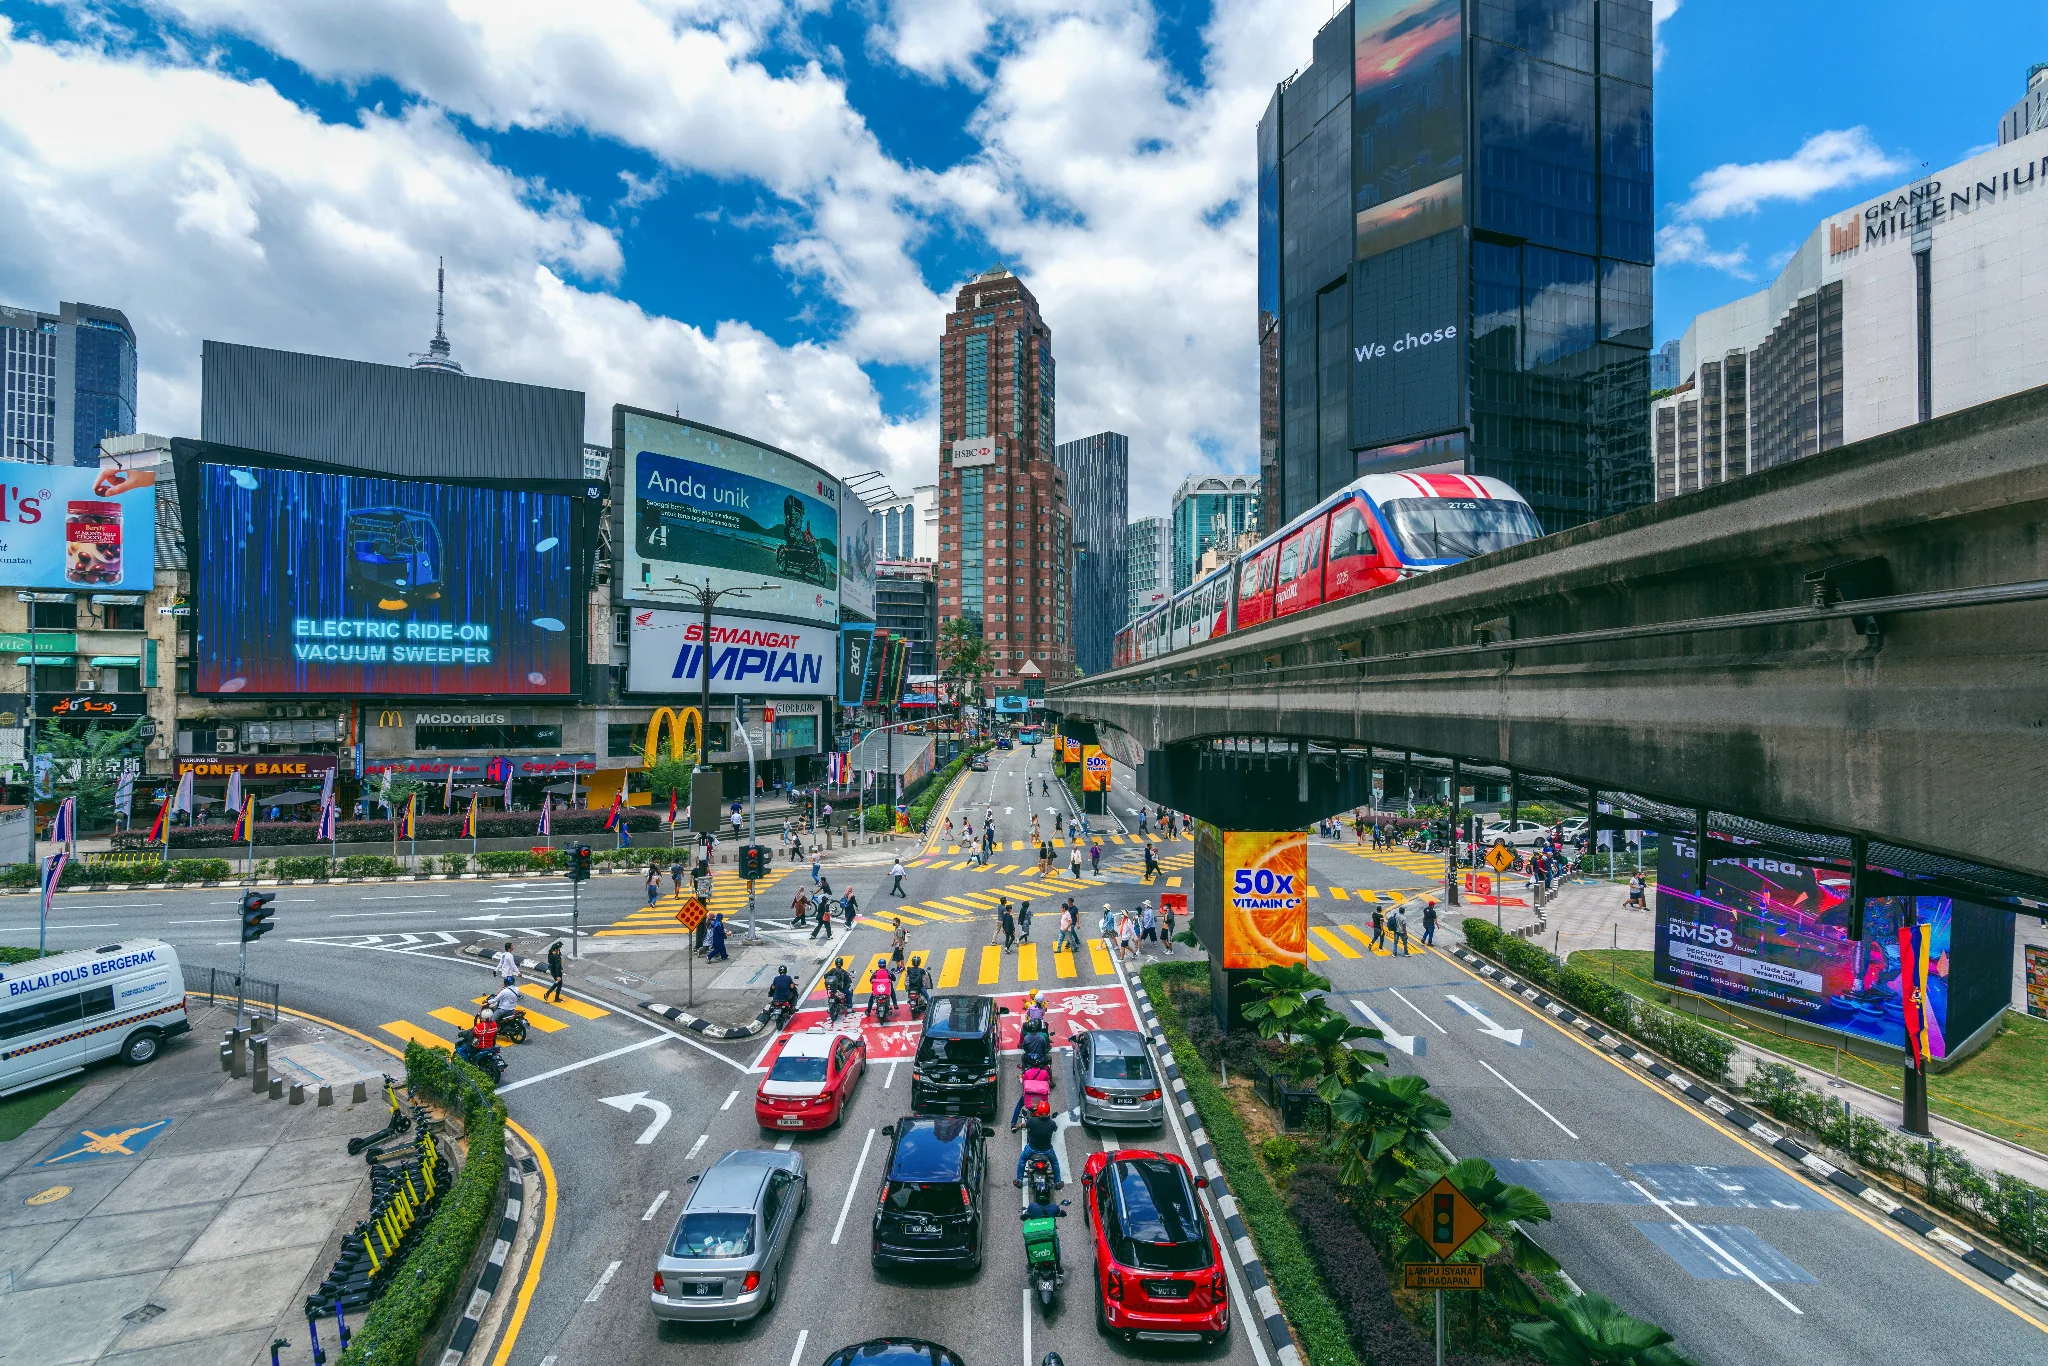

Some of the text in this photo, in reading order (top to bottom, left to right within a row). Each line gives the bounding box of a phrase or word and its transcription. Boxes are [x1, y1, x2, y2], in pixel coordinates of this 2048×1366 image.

[1865, 181, 1941, 220] GRAND
[1354, 325, 1457, 362] We chose
[954, 448, 978, 459] HSBC
[647, 470, 750, 510] Anda unik
[1447, 501, 1477, 510] 2725
[1336, 570, 1349, 586] 2725
[296, 620, 488, 641] ELECTRIC RIDE-ON
[684, 624, 800, 650] SEMANGAT
[294, 643, 490, 663] VACUUM SWEEPER
[851, 642, 860, 676] acer
[672, 644, 823, 684] IMPIAN
[776, 702, 815, 714] GIORDANO
[415, 713, 505, 725] McDonald's
[179, 763, 249, 776] HONEY
[255, 763, 307, 775] BAKE
[1086, 757, 1107, 766] 50x
[1233, 869, 1294, 895] 50x
[1233, 899, 1283, 909] VITAMIN
[10, 950, 156, 996] BALAI POLIS BERGERAK
[1751, 968, 1803, 985] Tersembunyi
[1759, 964, 1796, 979] Tiada Caj
[1669, 965, 1709, 981] Dapatkan
[1710, 976, 1749, 992] sekarang
[1751, 987, 1785, 1000] melalui
[1786, 995, 1821, 1010] yes.my
[1409, 1267, 1478, 1276] LAMPU ISYARAT
[1417, 1277, 1470, 1286] DI HADAPAN
